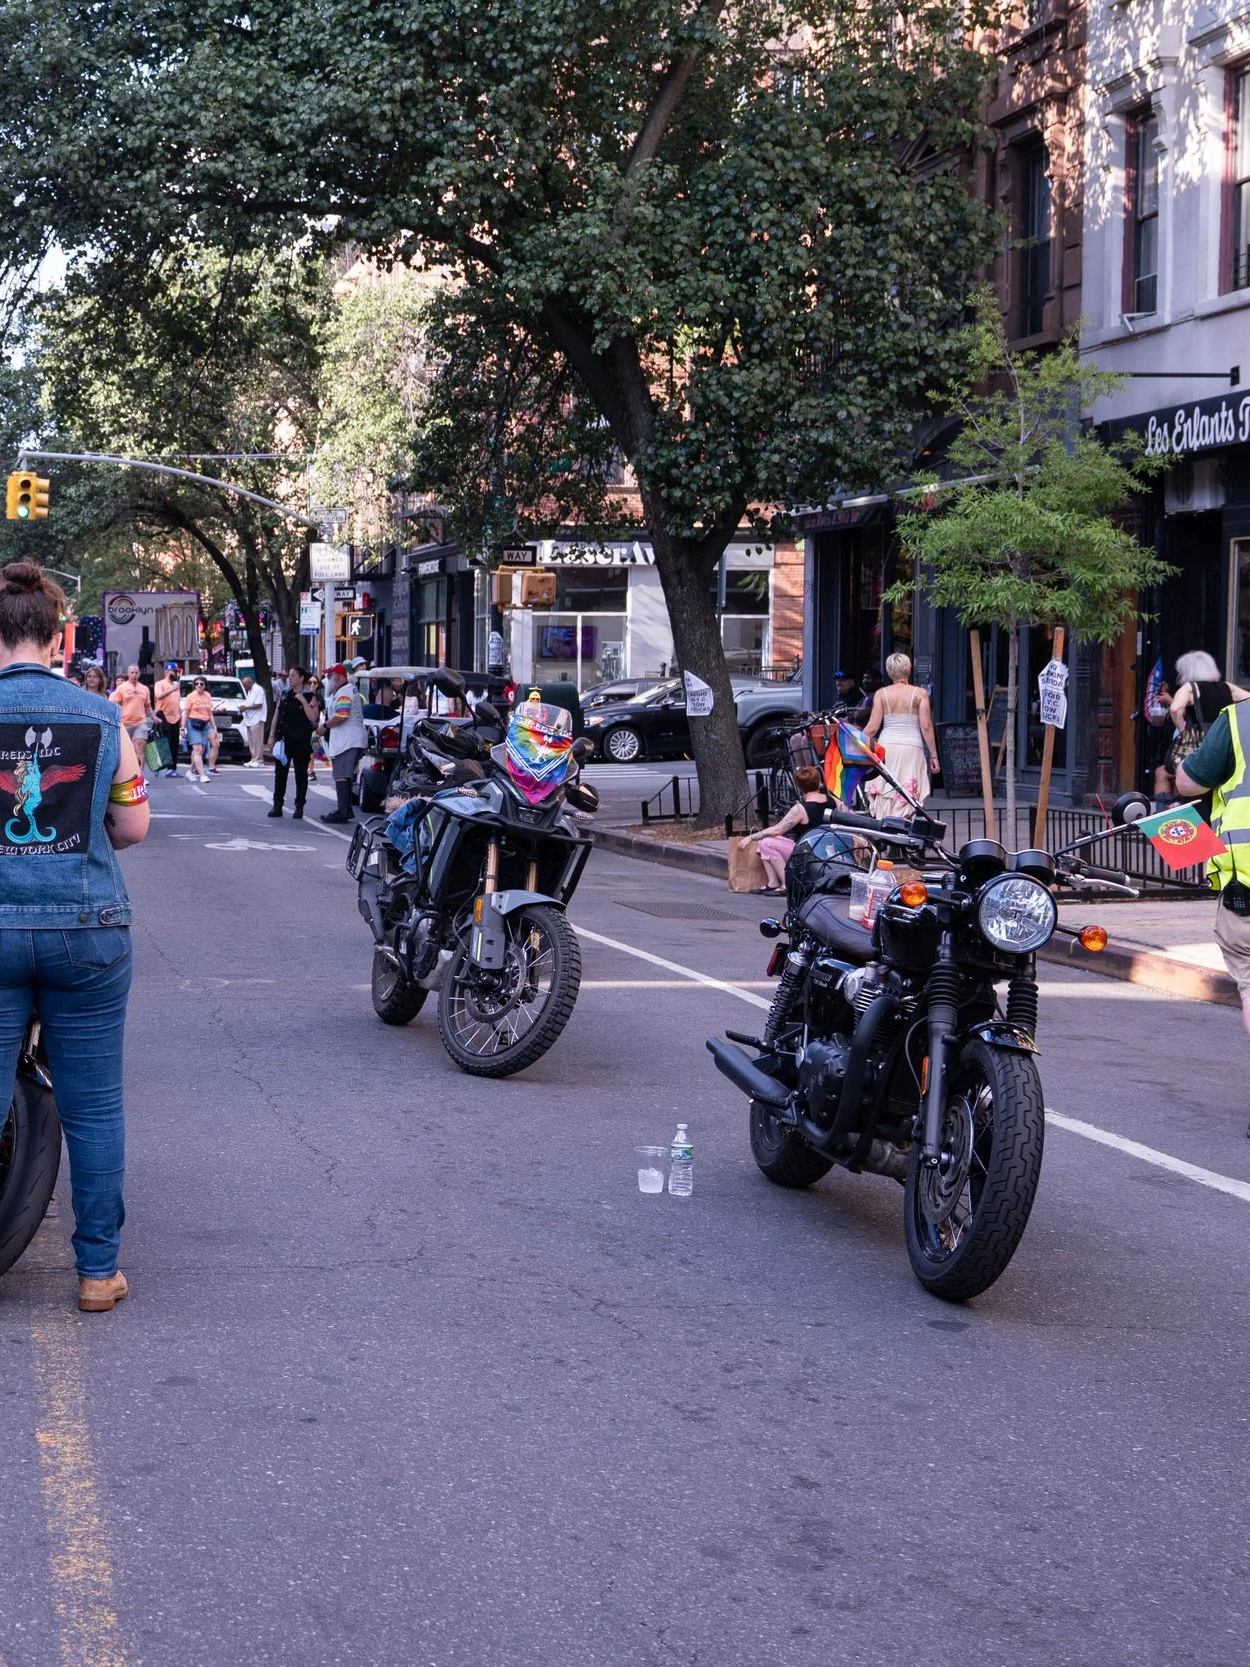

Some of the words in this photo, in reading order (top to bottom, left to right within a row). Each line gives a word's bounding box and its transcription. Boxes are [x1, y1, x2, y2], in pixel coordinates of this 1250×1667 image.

[1145, 416, 1170, 456] Les
[1173, 401, 1235, 452] Enfants
[506, 551, 527, 560] WAY
[107, 606, 153, 615] brooklyn
[39, 747, 61, 757] MC
[20, 845, 56, 855] YORK
[56, 833, 81, 851] CITY
